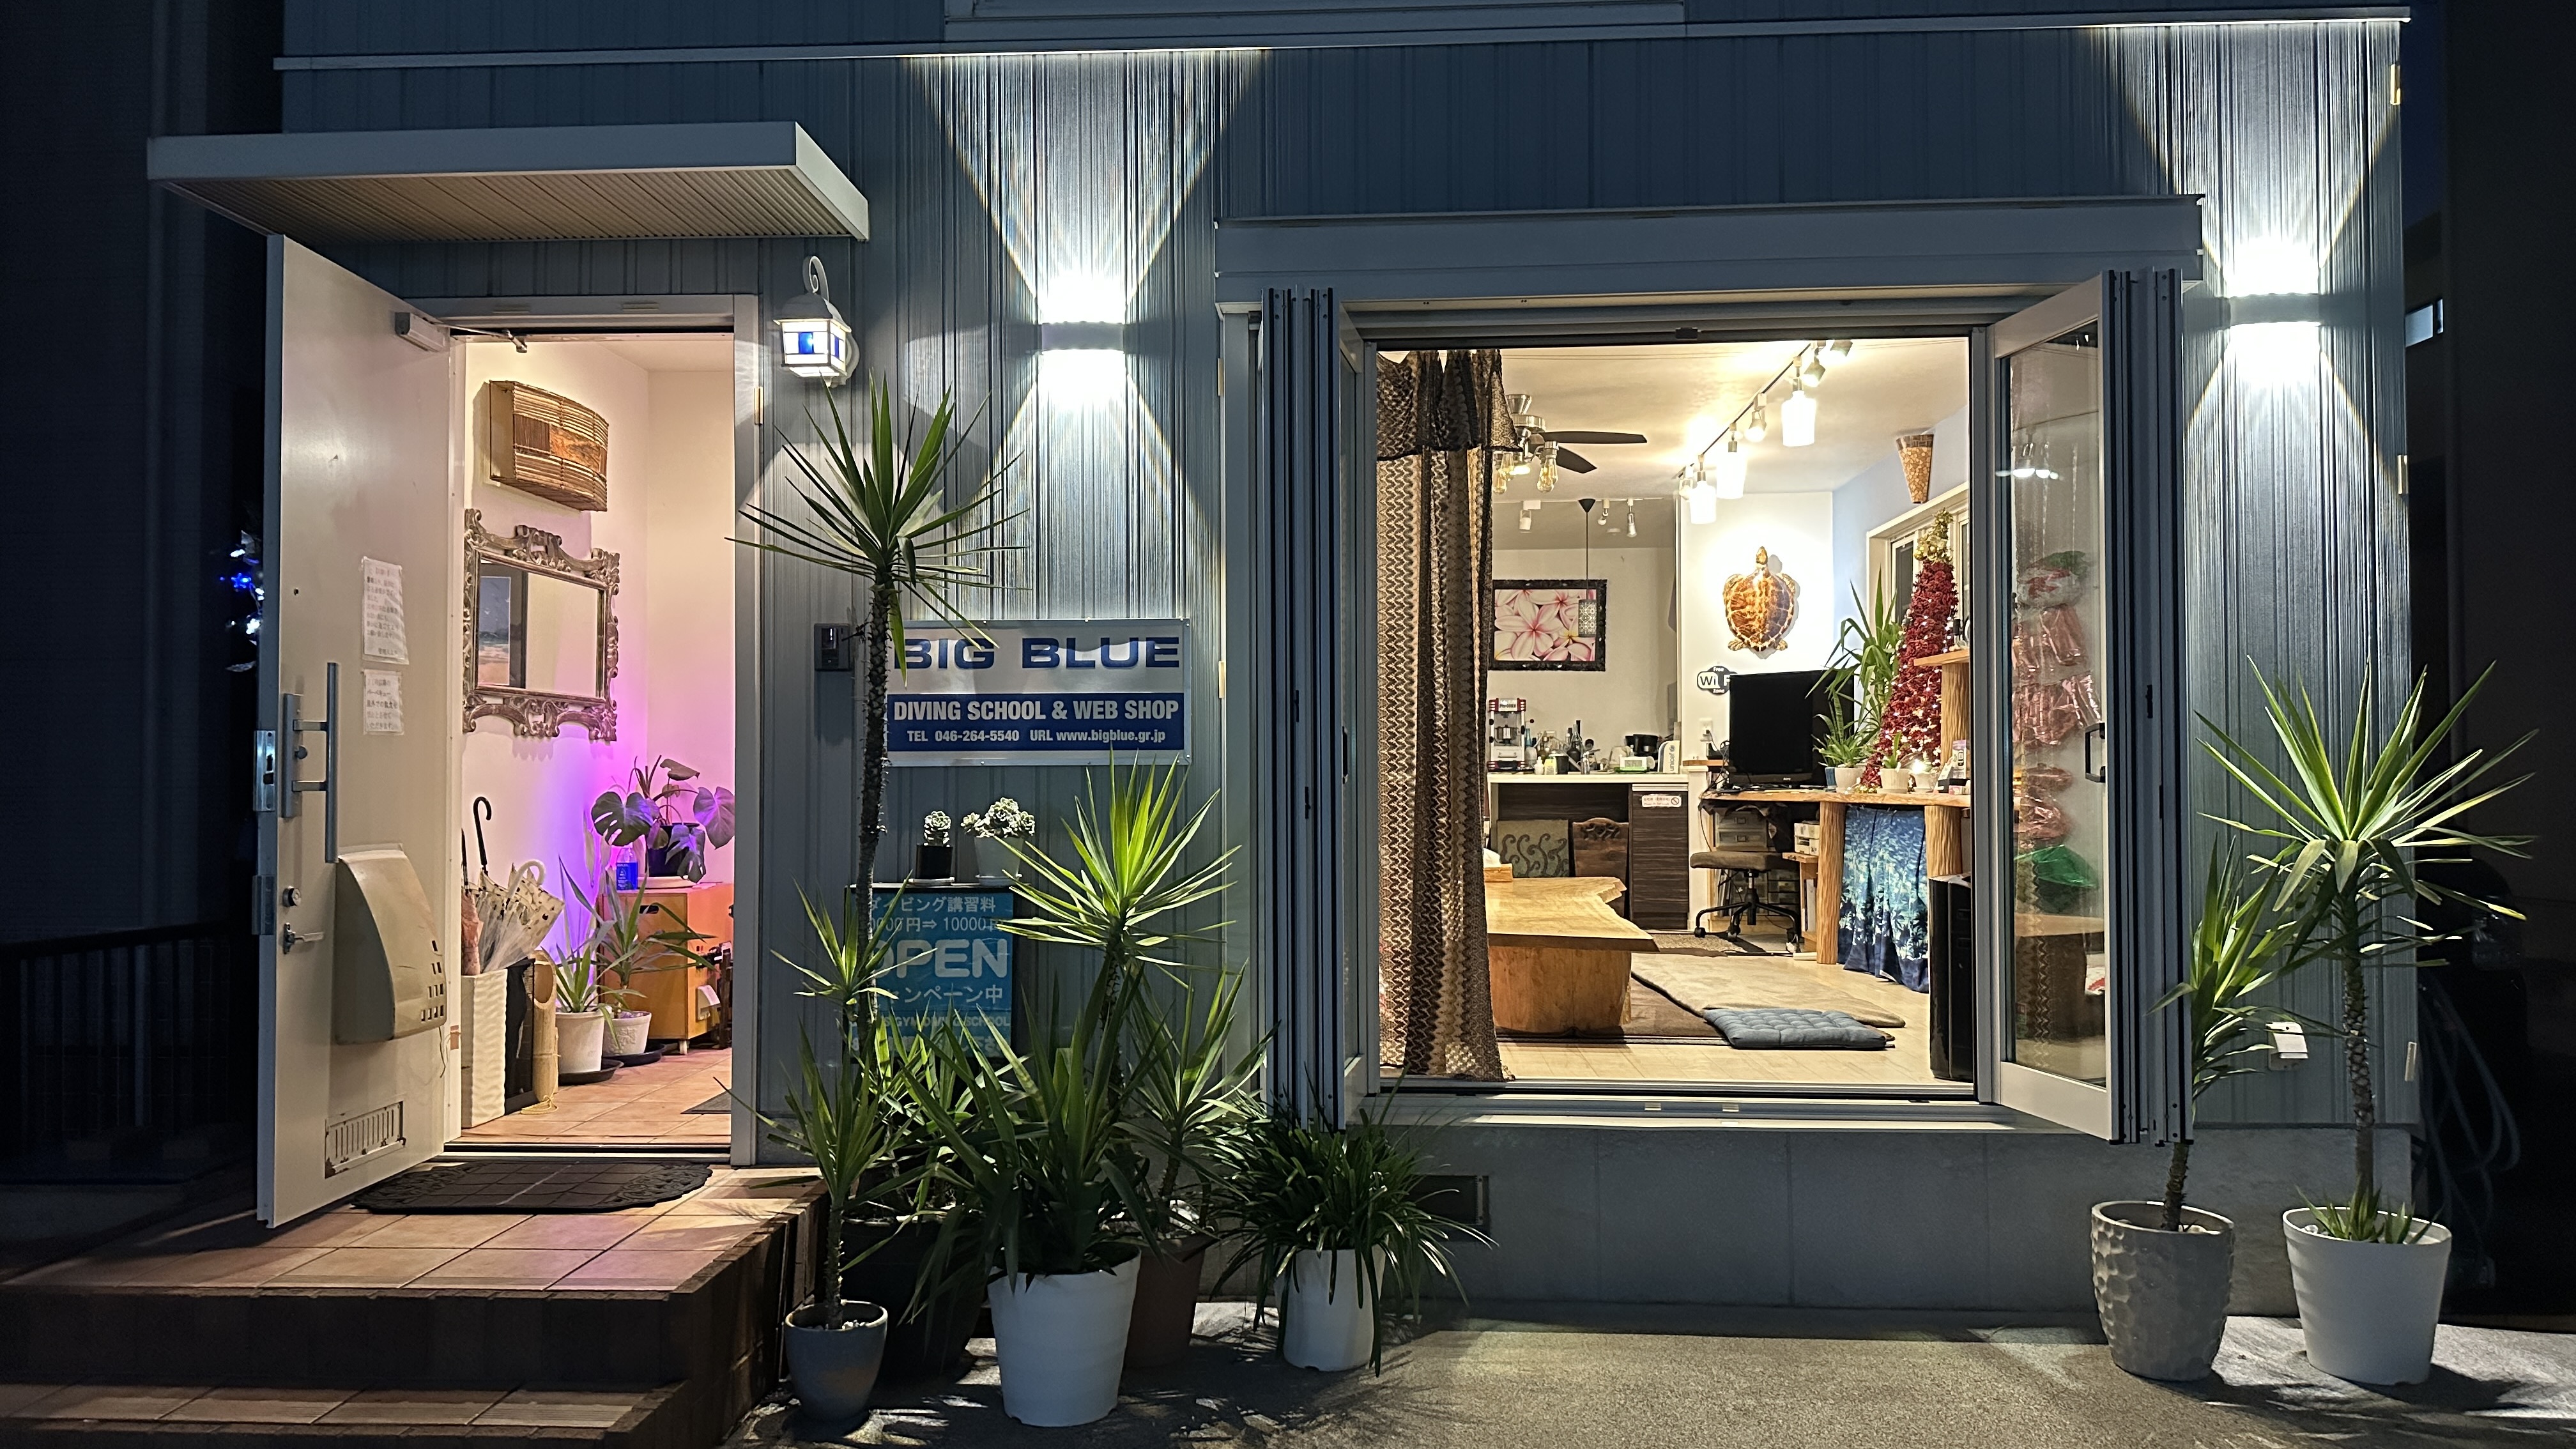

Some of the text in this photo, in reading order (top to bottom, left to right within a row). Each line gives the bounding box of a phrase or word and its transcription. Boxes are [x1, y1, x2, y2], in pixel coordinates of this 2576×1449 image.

[894, 636, 1179, 669] BIG BLUE
[894, 700, 1179, 721] DIVING SCHOOL & WEB SHOP
[907, 729, 1166, 743] TEL 046-264-5540 URL www.bigblue.gr.jp
[891, 984, 1003, 1004] ンペーン中
